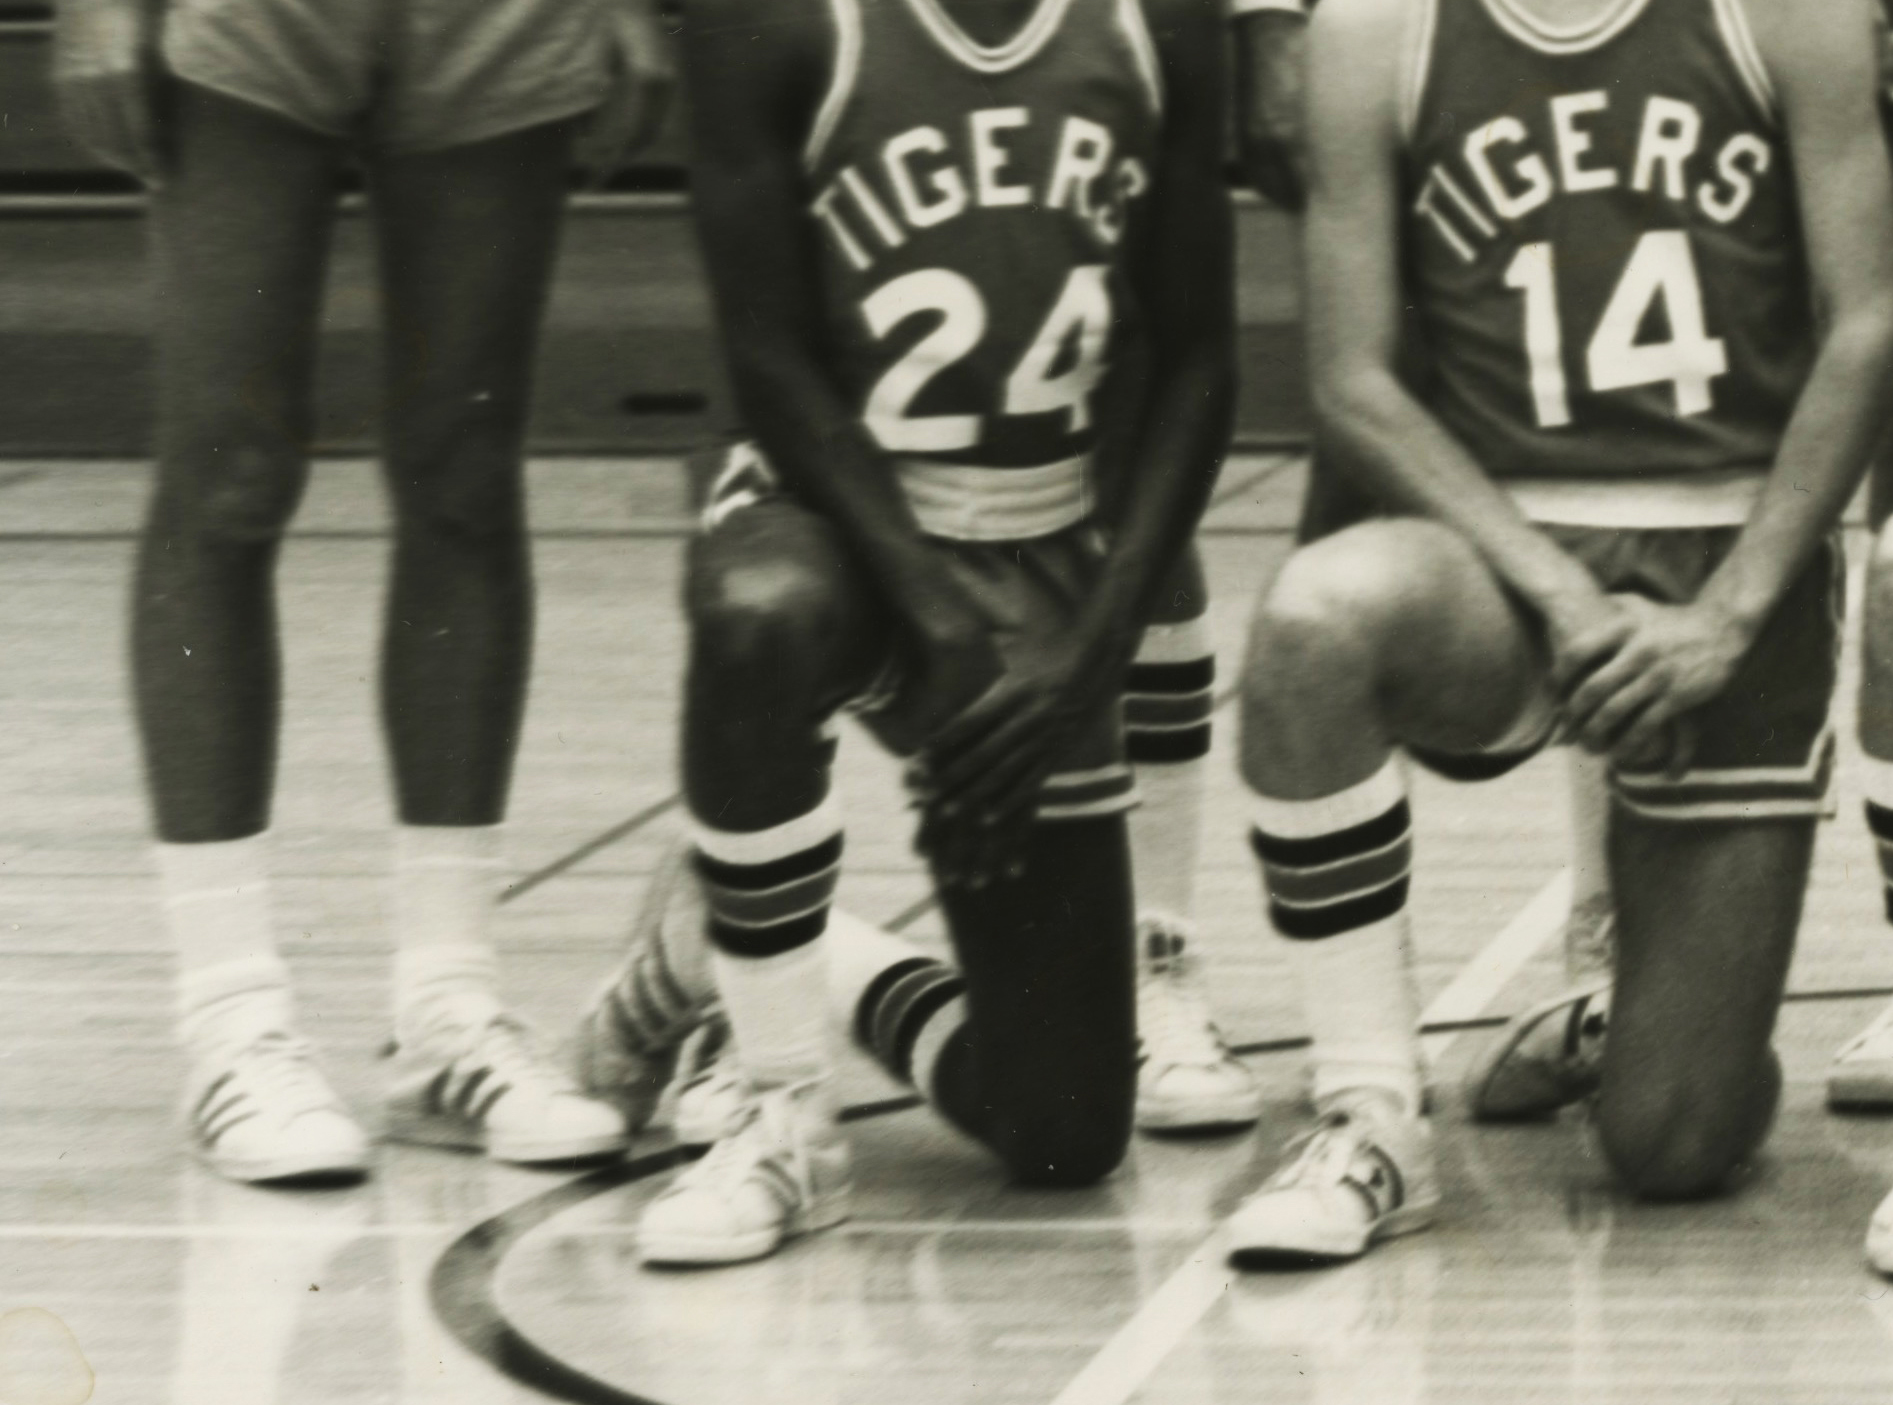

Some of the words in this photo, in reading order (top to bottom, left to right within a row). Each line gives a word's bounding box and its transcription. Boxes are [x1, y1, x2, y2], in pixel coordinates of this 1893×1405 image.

[810, 107, 1149, 271] TIGERS
[1415, 91, 1768, 262] TIGERS
[859, 263, 1113, 453] 24
[1503, 228, 1728, 428] 14
